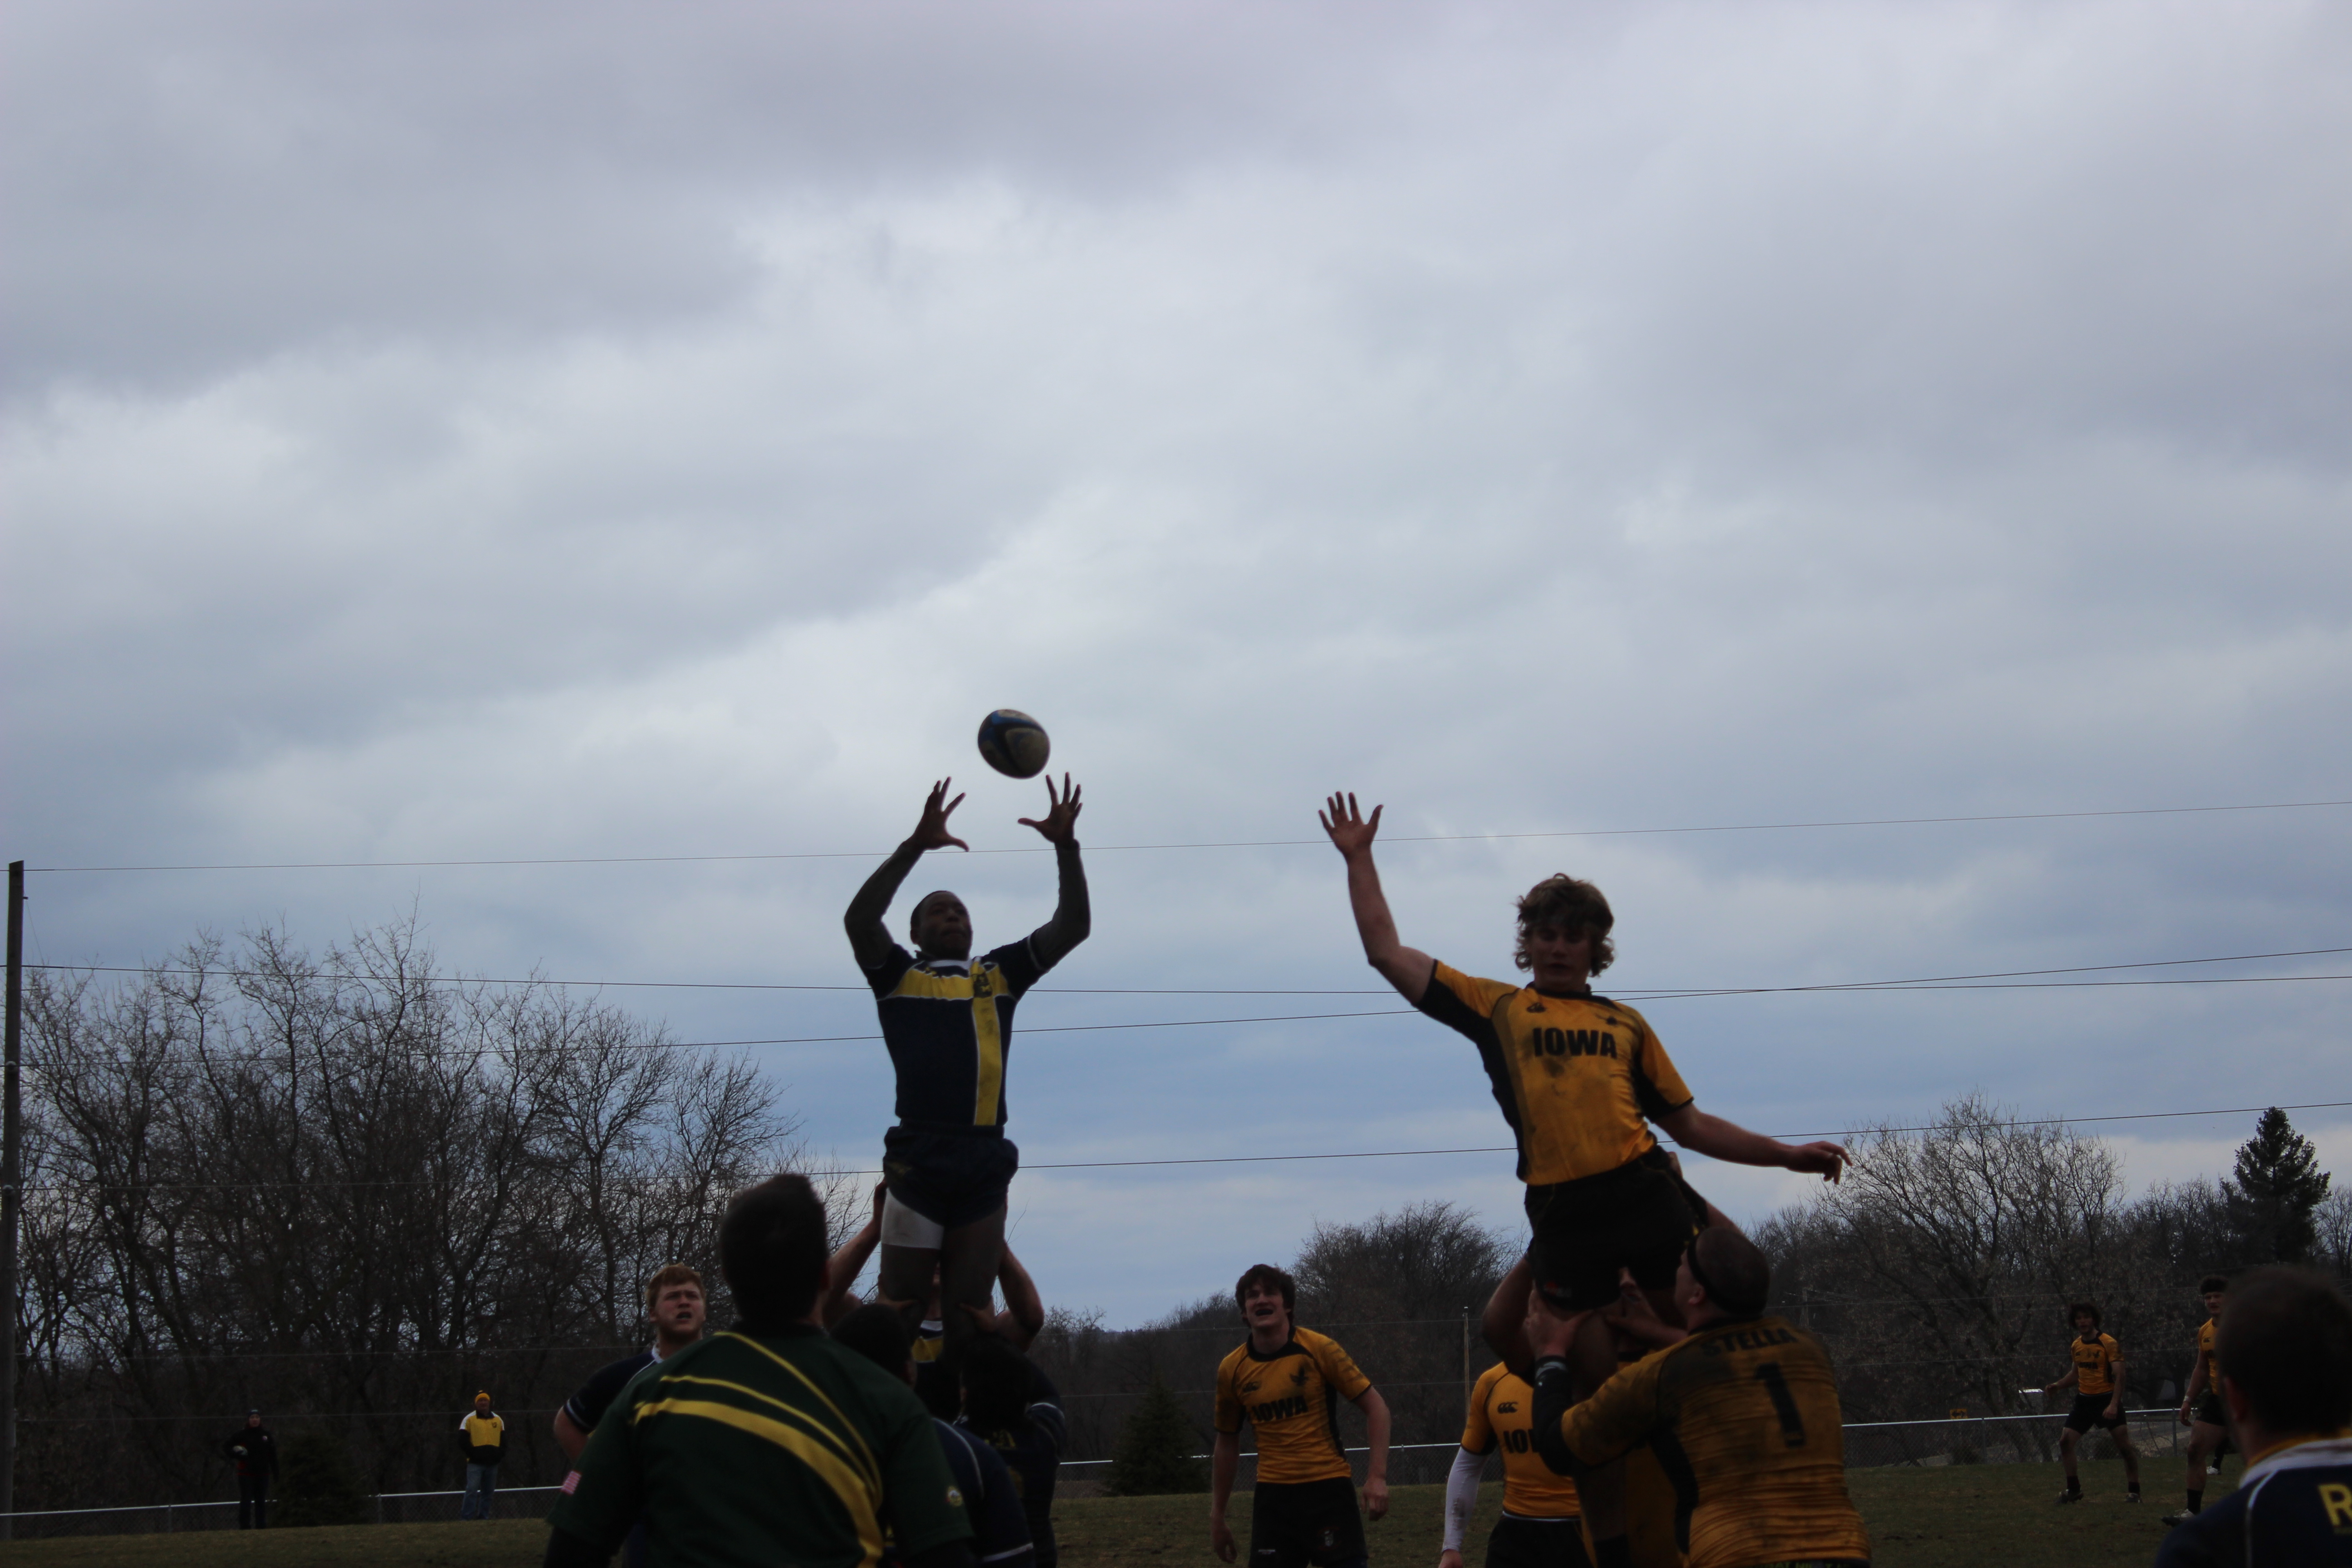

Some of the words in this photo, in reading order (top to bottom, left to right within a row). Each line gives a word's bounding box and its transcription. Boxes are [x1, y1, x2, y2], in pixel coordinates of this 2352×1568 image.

[1533, 1027, 1617, 1059] IOWA
[1701, 1328, 1798, 1357] STELLA
[1252, 1395, 1308, 1421] IOWA
[1755, 1362, 1806, 1447] 1
